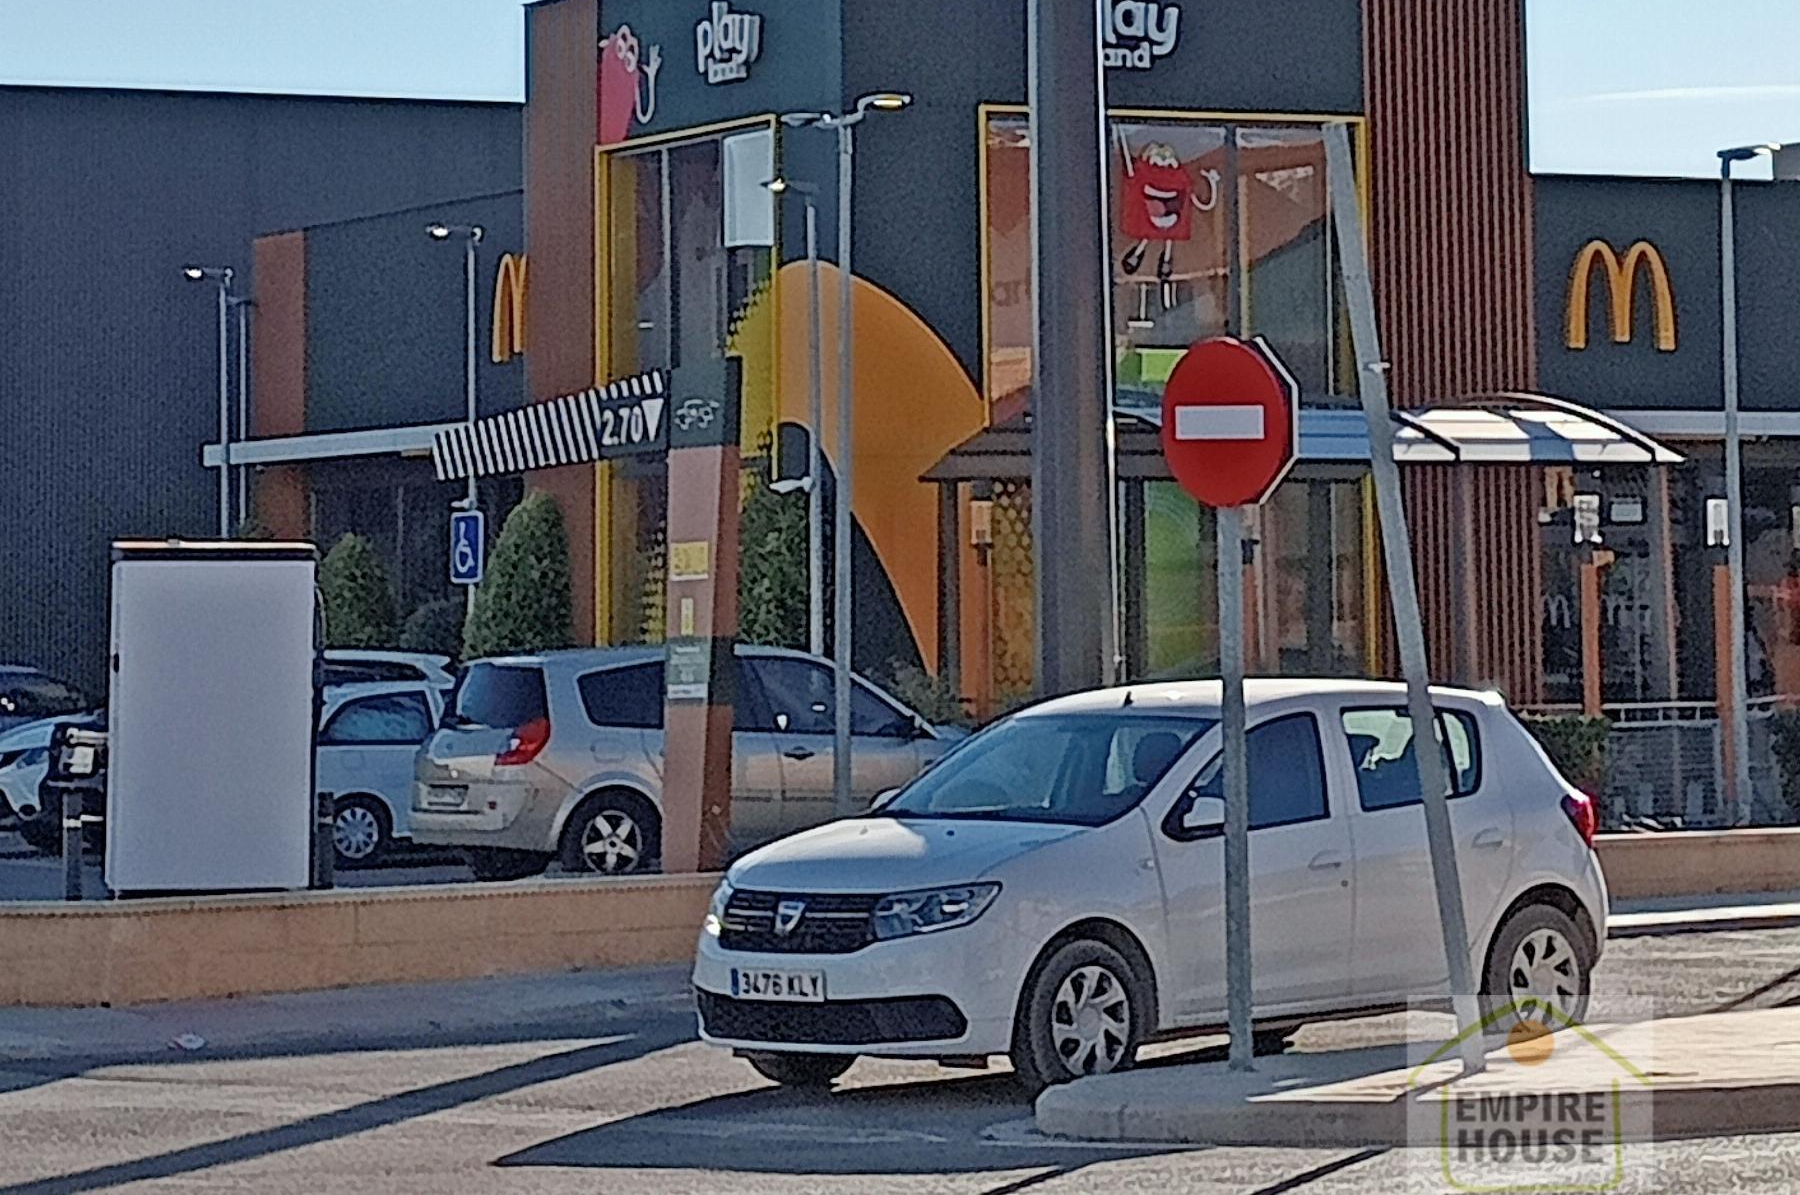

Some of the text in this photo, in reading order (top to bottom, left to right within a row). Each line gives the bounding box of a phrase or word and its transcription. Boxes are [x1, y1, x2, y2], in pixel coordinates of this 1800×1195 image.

[697, 1, 760, 73] play
[1103, 41, 1151, 69] and
[1566, 239, 1677, 351] M
[601, 405, 643, 446] 2.70
